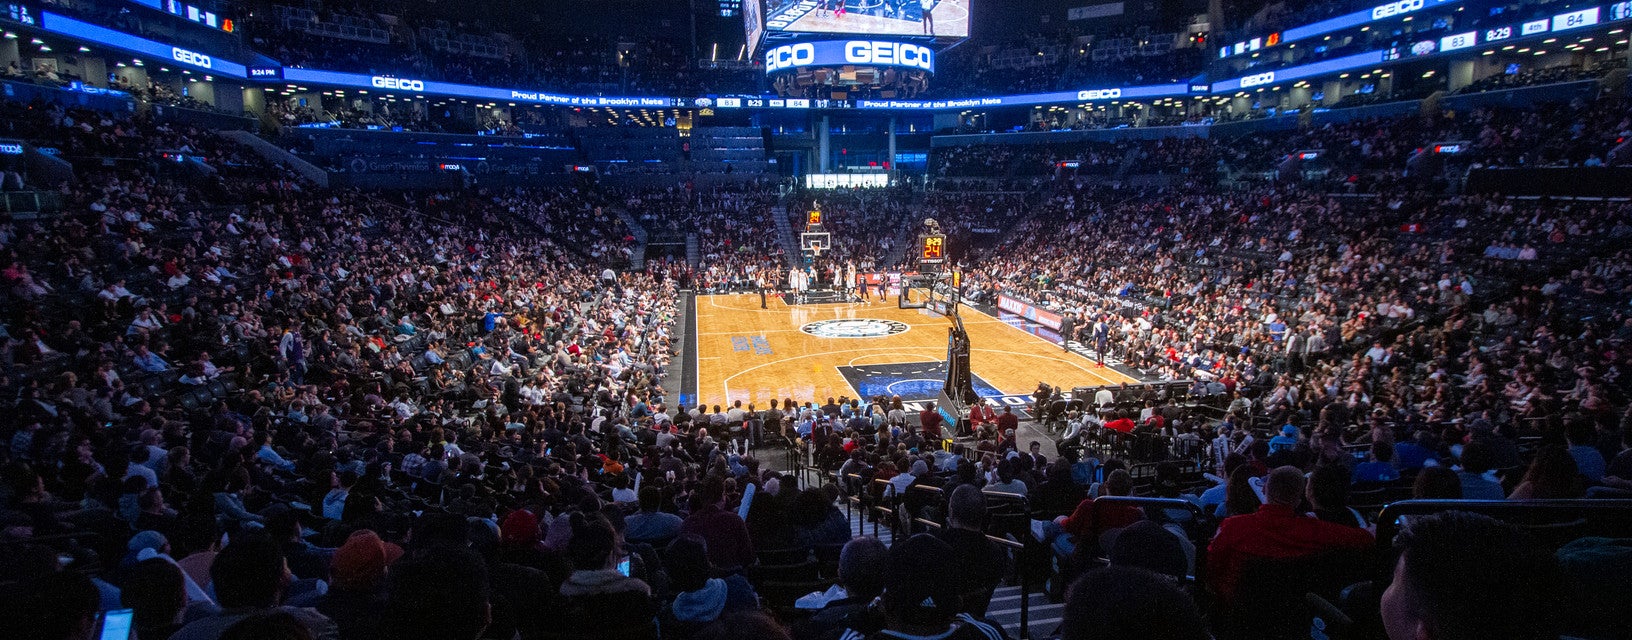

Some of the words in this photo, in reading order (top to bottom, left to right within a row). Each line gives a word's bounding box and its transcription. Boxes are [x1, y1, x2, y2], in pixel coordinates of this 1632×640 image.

[1372, 0, 1423, 20] GEICO
[1452, 37, 1464, 47] 83
[1486, 27, 1511, 41] 8:29
[1567, 13, 1584, 26] 84
[172, 47, 211, 68] GEICO
[845, 40, 931, 70] GEICO
[372, 76, 424, 91] GEICO
[1240, 72, 1274, 88] GEICO
[511, 91, 537, 100] Proud
[539, 93, 569, 103] Partner
[572, 96, 579, 104] of
[582, 97, 596, 105] the
[599, 98, 638, 106] Brooklyn
[1077, 88, 1121, 100] GEICO
[948, 99, 980, 107] Brooklyn
[926, 238, 942, 246] 8:29
[924, 245, 940, 258] 24
